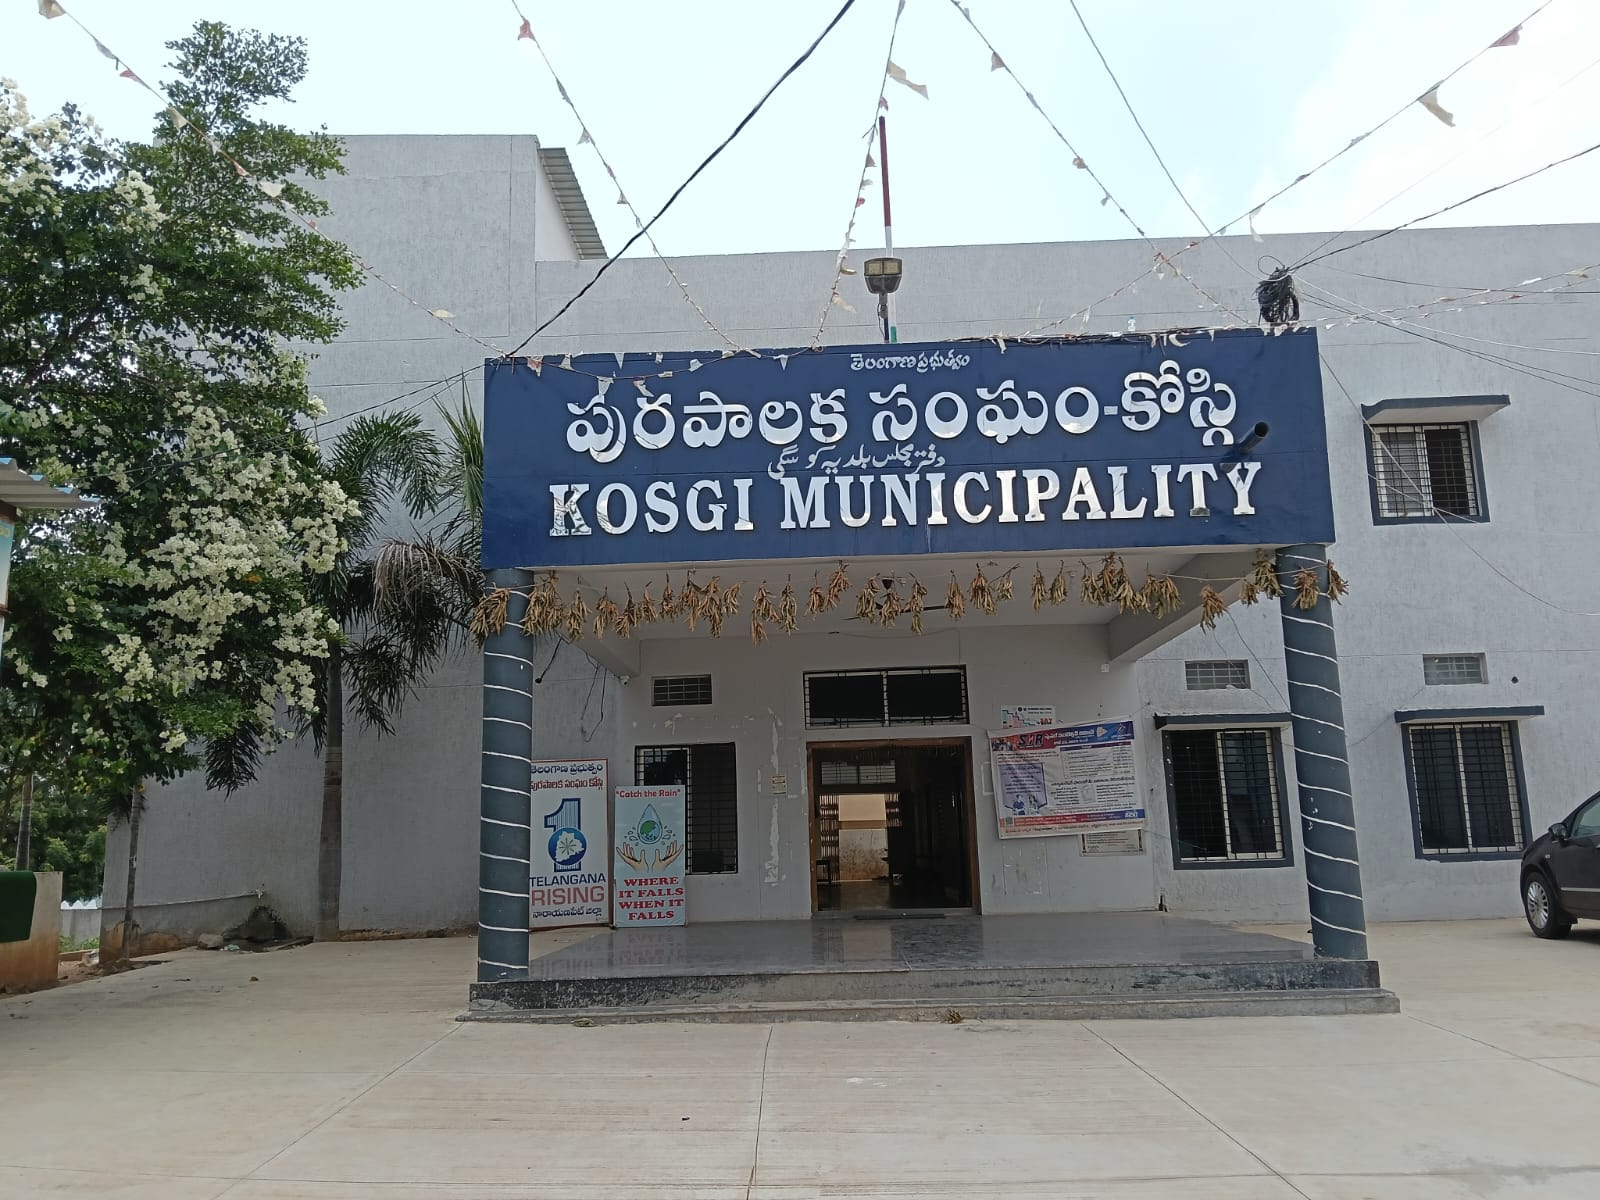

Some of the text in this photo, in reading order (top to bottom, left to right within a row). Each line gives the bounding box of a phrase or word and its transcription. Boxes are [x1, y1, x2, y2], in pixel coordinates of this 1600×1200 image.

[850, 349, 971, 373] తెలంగాణ ప్రభుత్వం
[566, 388, 848, 463] పురపాలక
[872, 442, 915, 468] مجلس
[913, 443, 946, 475] دفتر
[548, 461, 1263, 537] KOSGI MUNICIPALITY
[645, 789, 657, 798] the
[529, 872, 606, 887] TELANGANA
[624, 877, 679, 886] WHERE
[531, 886, 605, 906] RISING
[618, 888, 684, 898] IT FALLS
[618, 899, 684, 909] WHEN IT
[628, 911, 675, 921] FALLS
